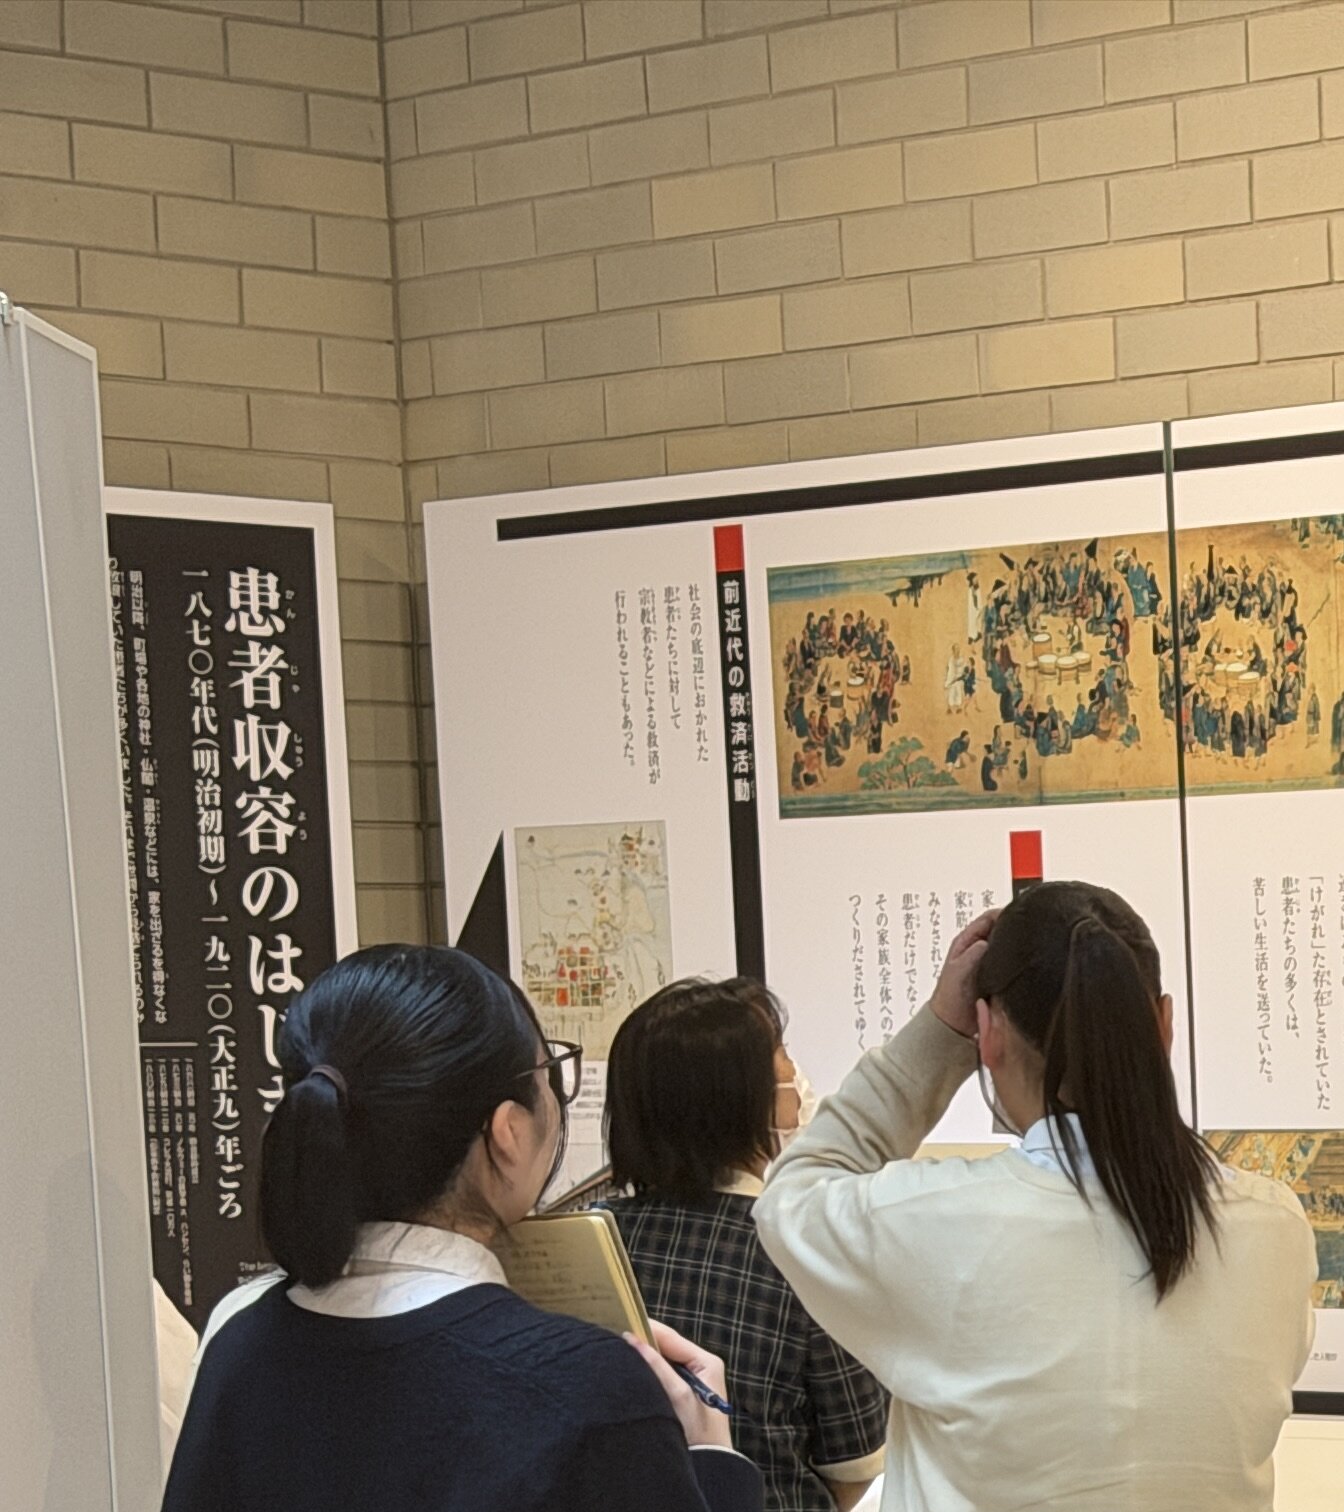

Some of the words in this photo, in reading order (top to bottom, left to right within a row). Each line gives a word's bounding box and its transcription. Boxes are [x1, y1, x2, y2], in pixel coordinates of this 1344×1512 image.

[722, 579, 751, 803] 前近代の救済活動
[1252, 876, 1273, 1084] 苦しい生活を送っていた。
[1281, 875, 1300, 1039] 患者たちの多くは、
[1309, 876, 1331, 1111] 「けがれ」た存在とされていた
